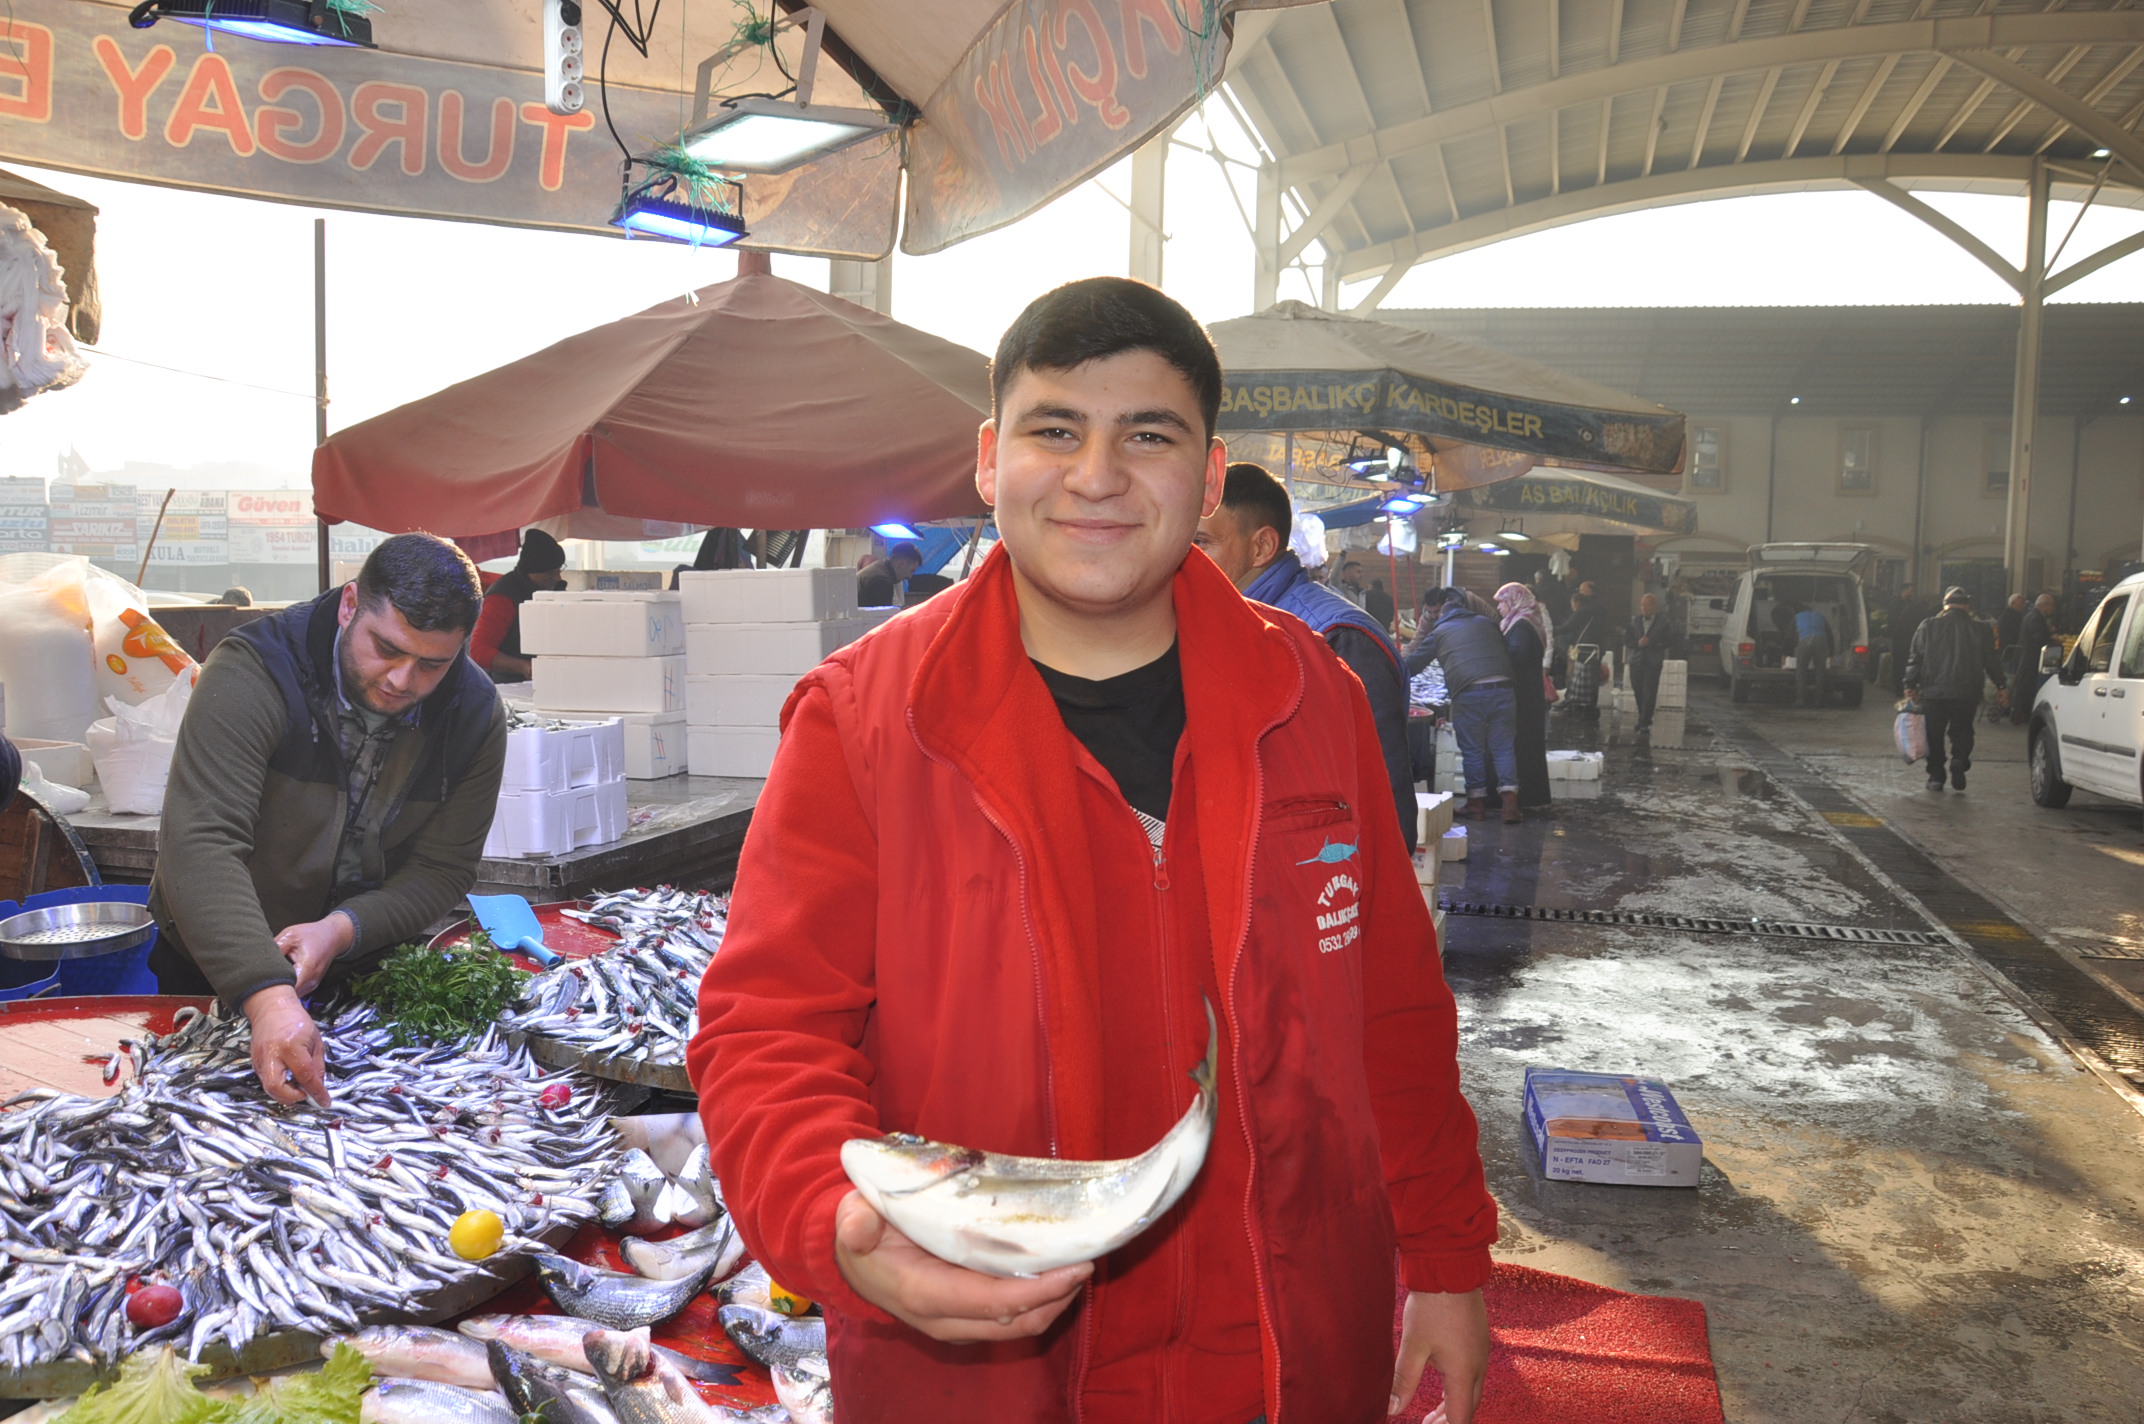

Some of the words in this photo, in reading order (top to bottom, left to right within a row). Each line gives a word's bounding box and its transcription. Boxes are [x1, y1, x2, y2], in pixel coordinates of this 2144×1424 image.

[1386, 383, 1544, 439] KARDEŞLER
[237, 496, 301, 513] Güven
[1520, 484, 1546, 504] AS
[1549, 485, 1639, 516] BALIKÇILIK
[1317, 873, 1360, 907] TURGAY
[1318, 933, 1343, 954] 0532
[1564, 1156, 1584, 1164] EFTA
[1562, 1168, 1570, 1176] kg
